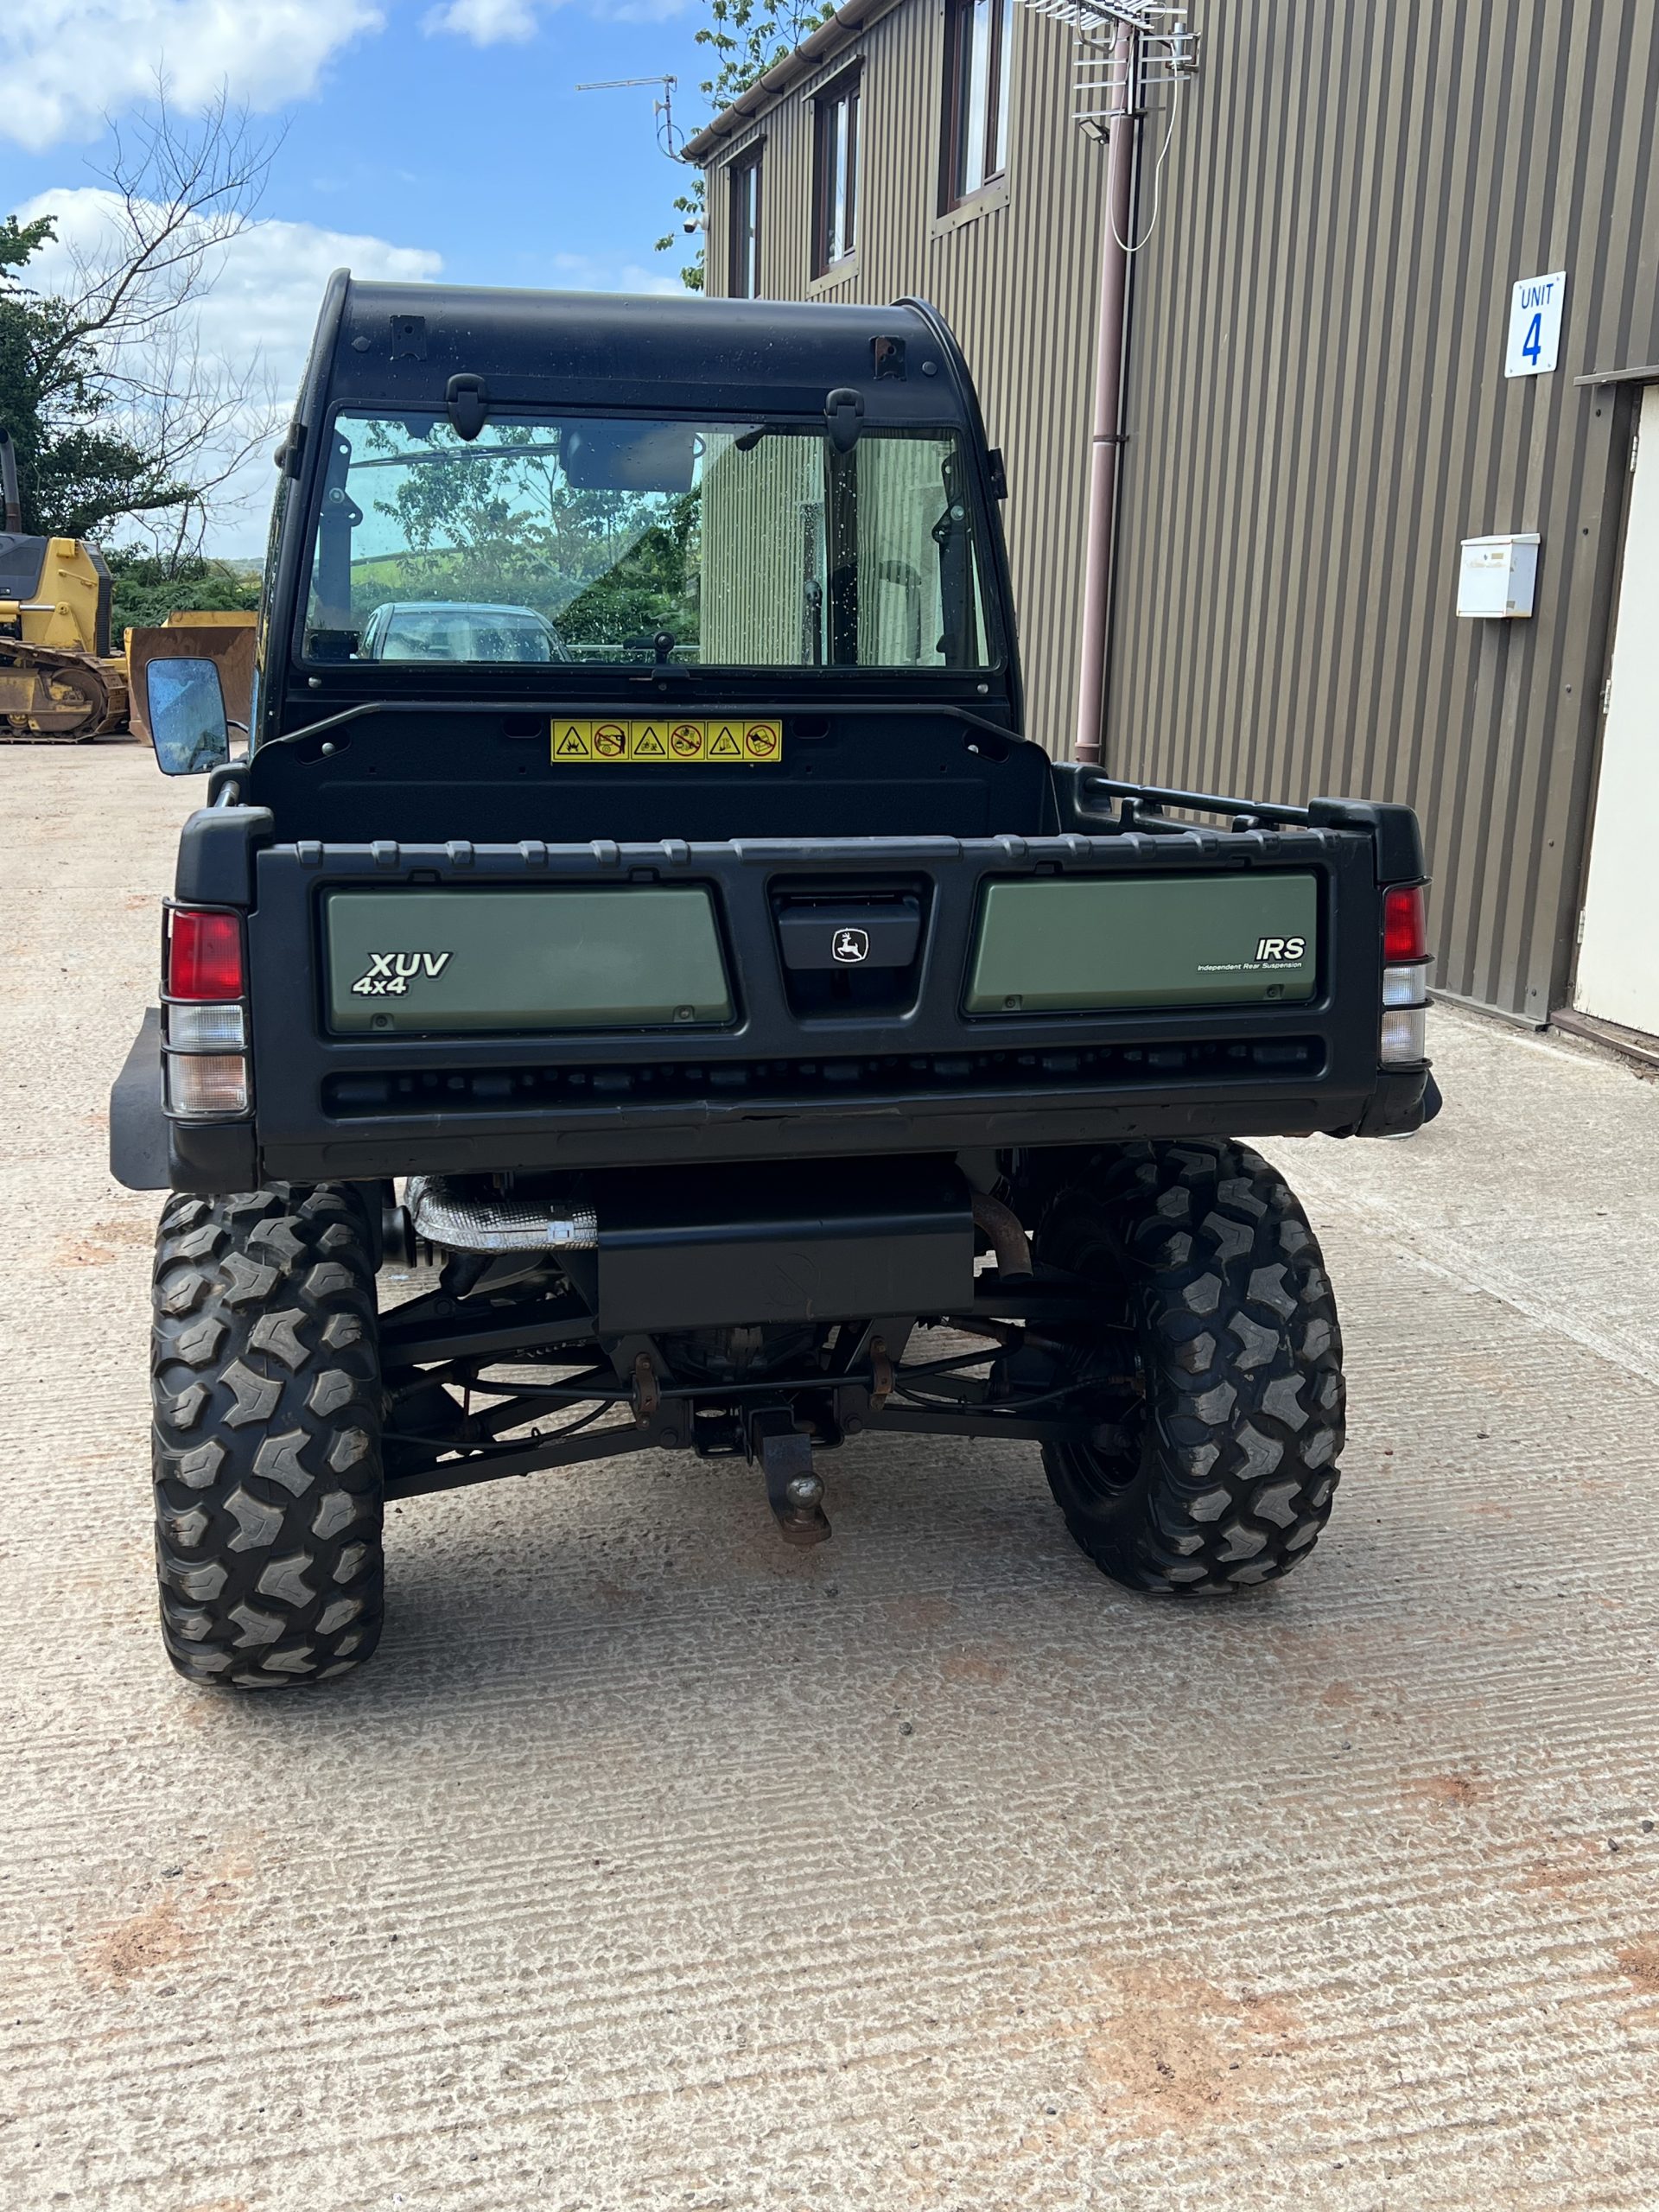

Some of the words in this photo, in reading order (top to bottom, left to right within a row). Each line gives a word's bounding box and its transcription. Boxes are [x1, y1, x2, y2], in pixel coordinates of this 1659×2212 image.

[1521, 283, 1554, 309] UNIT
[1522, 312, 1542, 365] 4
[1255, 938, 1306, 960] IRS
[365, 952, 450, 977] XUV
[352, 976, 407, 995] 4x4
